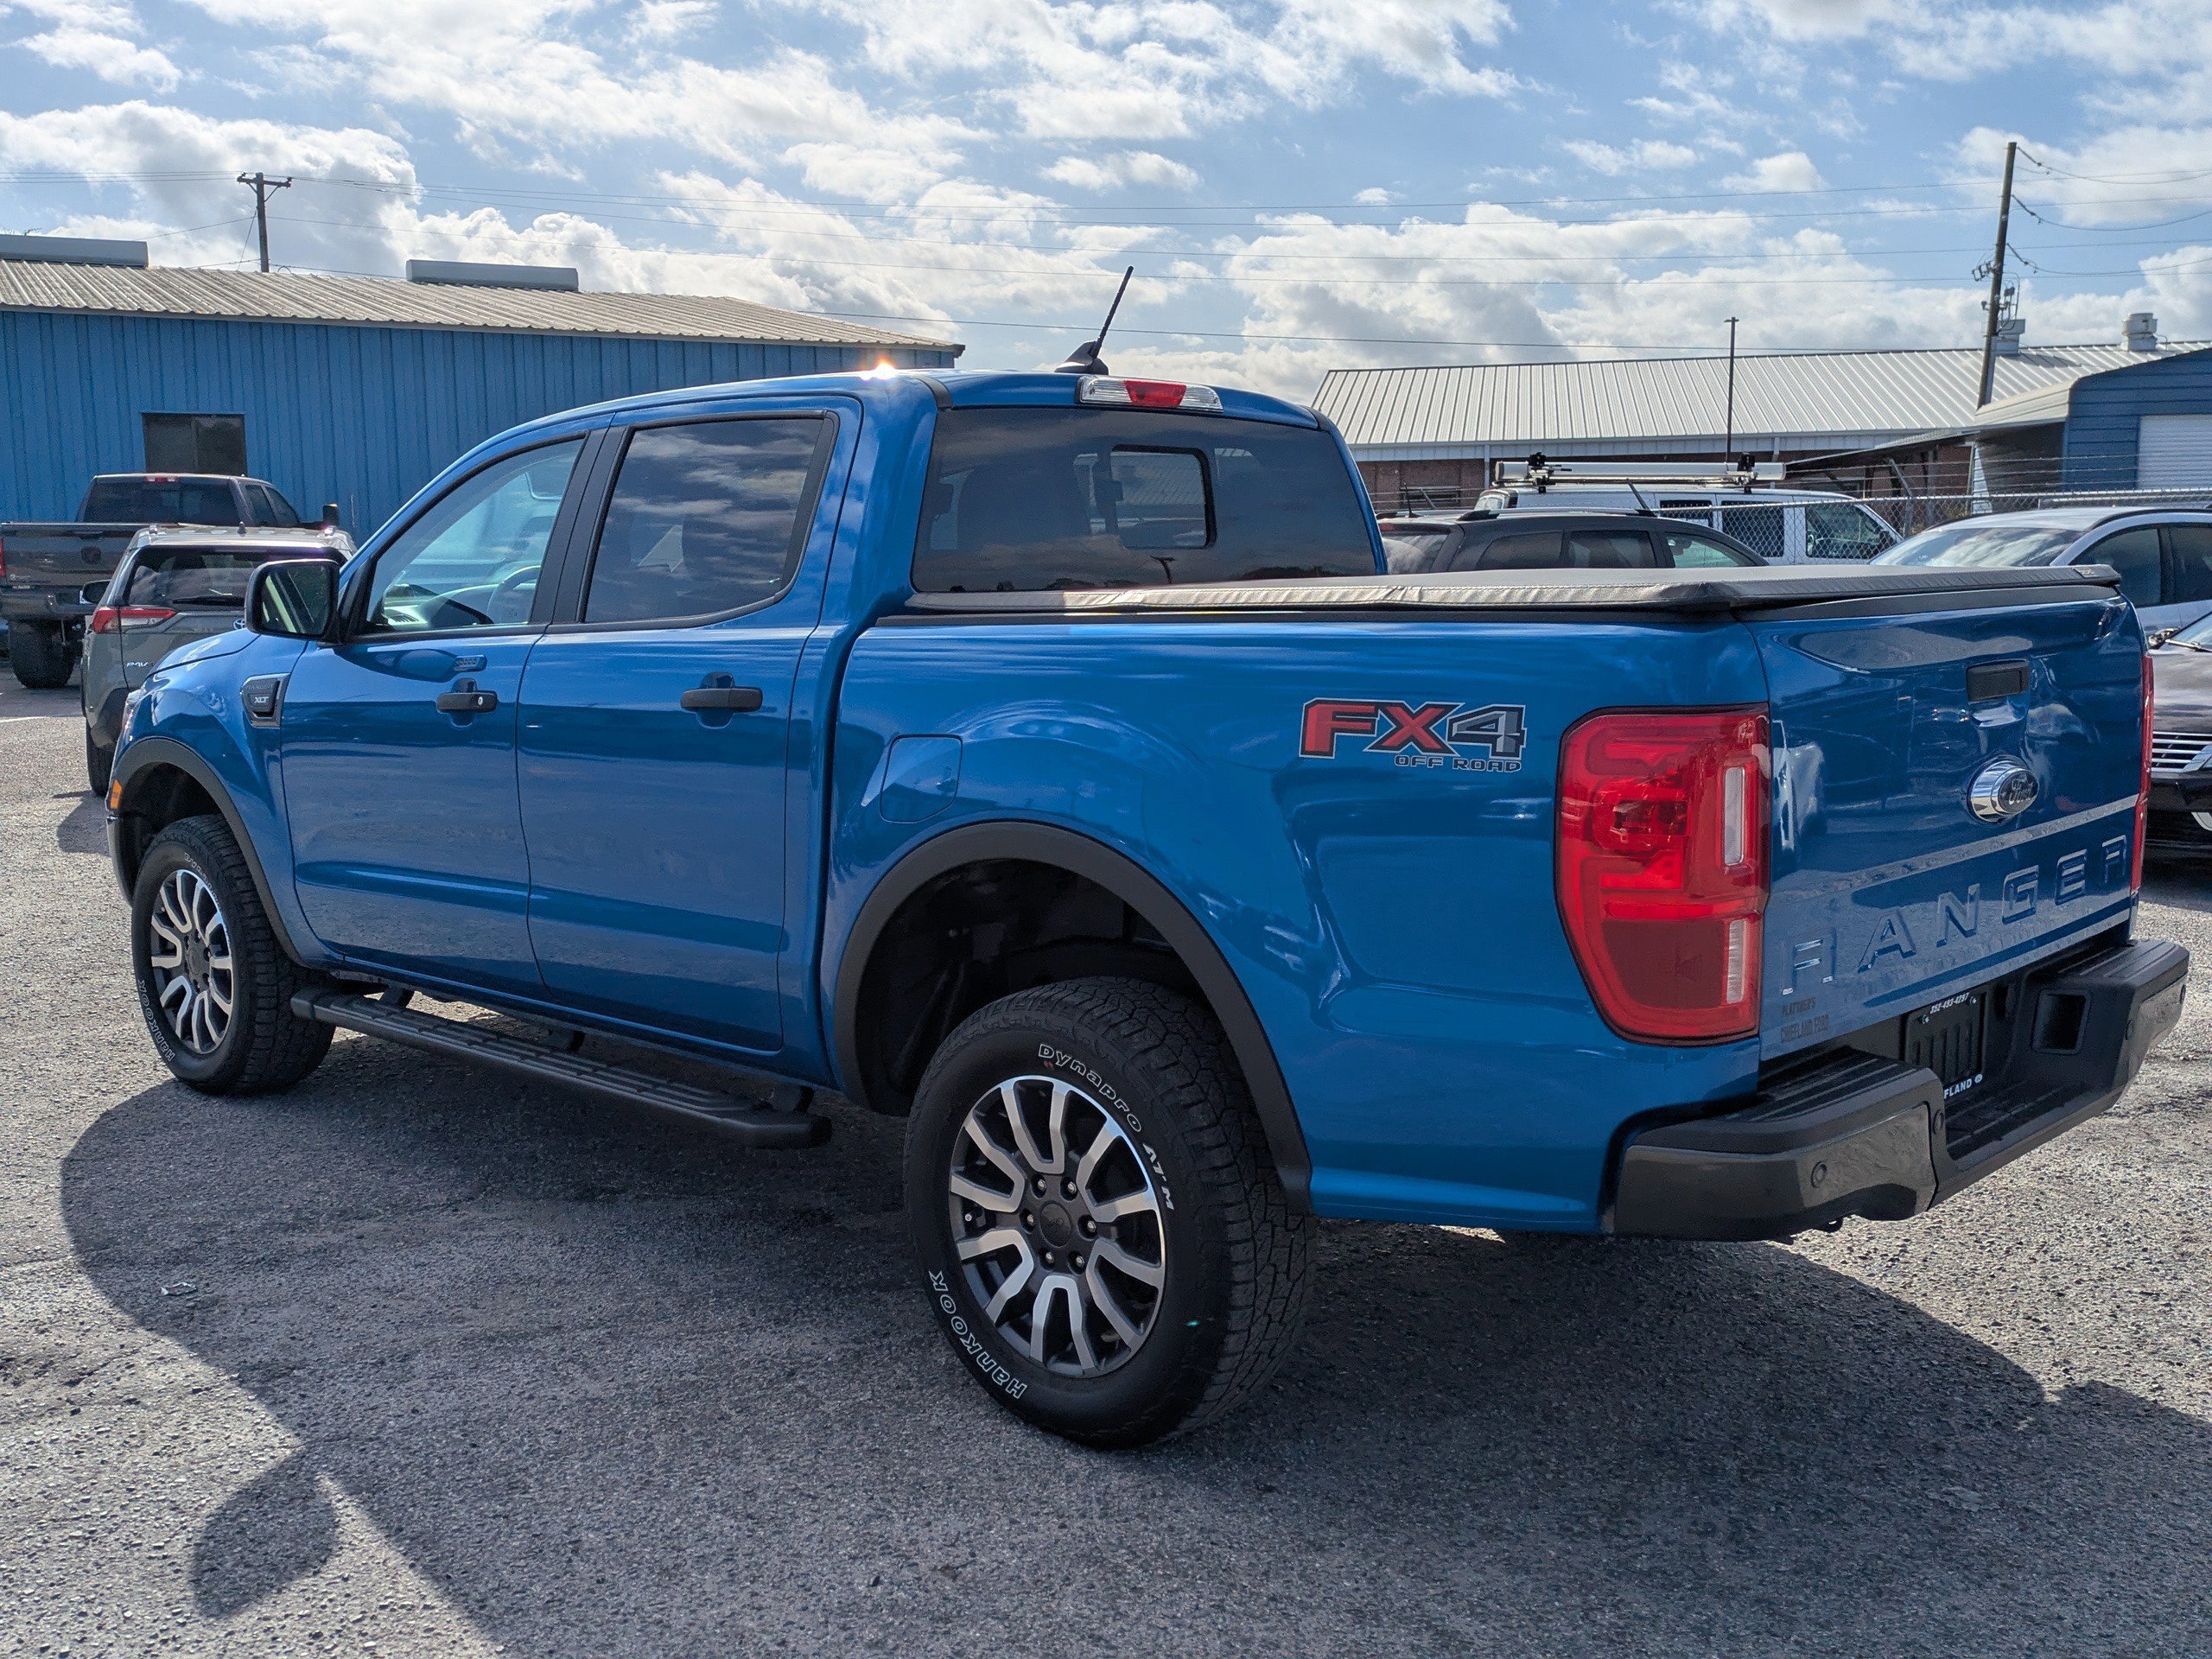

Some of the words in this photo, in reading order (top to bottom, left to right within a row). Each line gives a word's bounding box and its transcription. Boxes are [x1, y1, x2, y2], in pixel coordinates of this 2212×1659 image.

[253, 696, 270, 704] XLT
[1299, 697, 1527, 760] FX4
[1395, 754, 1444, 768] OFF
[1452, 758, 1522, 772] ROAD
[1781, 834, 2128, 995] RANGER
[1943, 1077, 1973, 1099] FLAND
